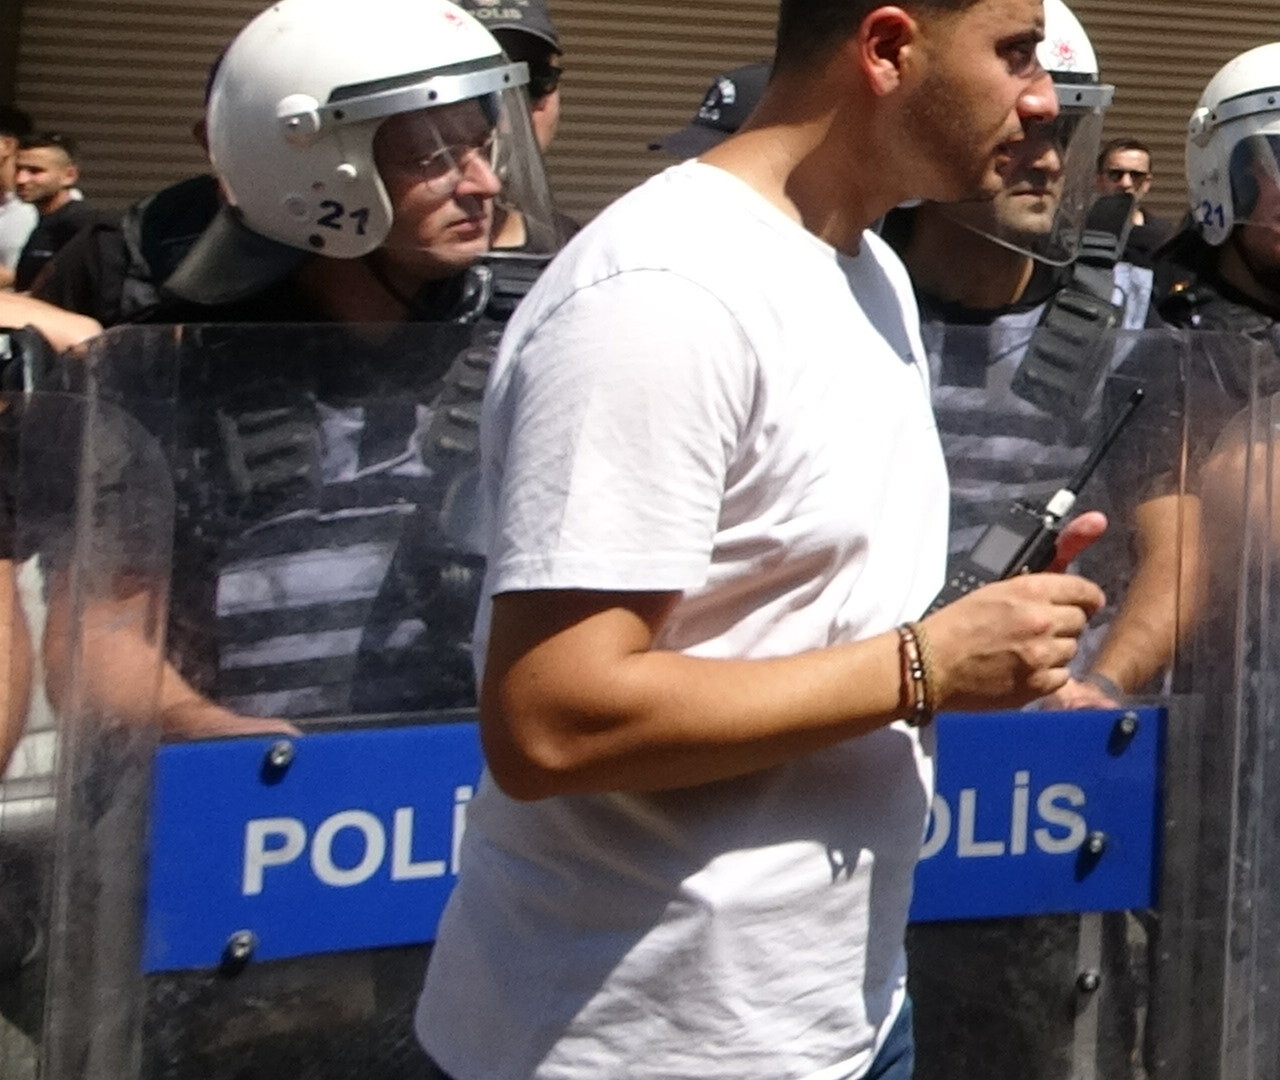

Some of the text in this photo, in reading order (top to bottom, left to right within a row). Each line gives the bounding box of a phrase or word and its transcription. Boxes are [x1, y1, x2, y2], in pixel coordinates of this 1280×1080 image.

[317, 200, 370, 235] 21
[1202, 200, 1225, 229] 21
[243, 786, 473, 896] POLİ
